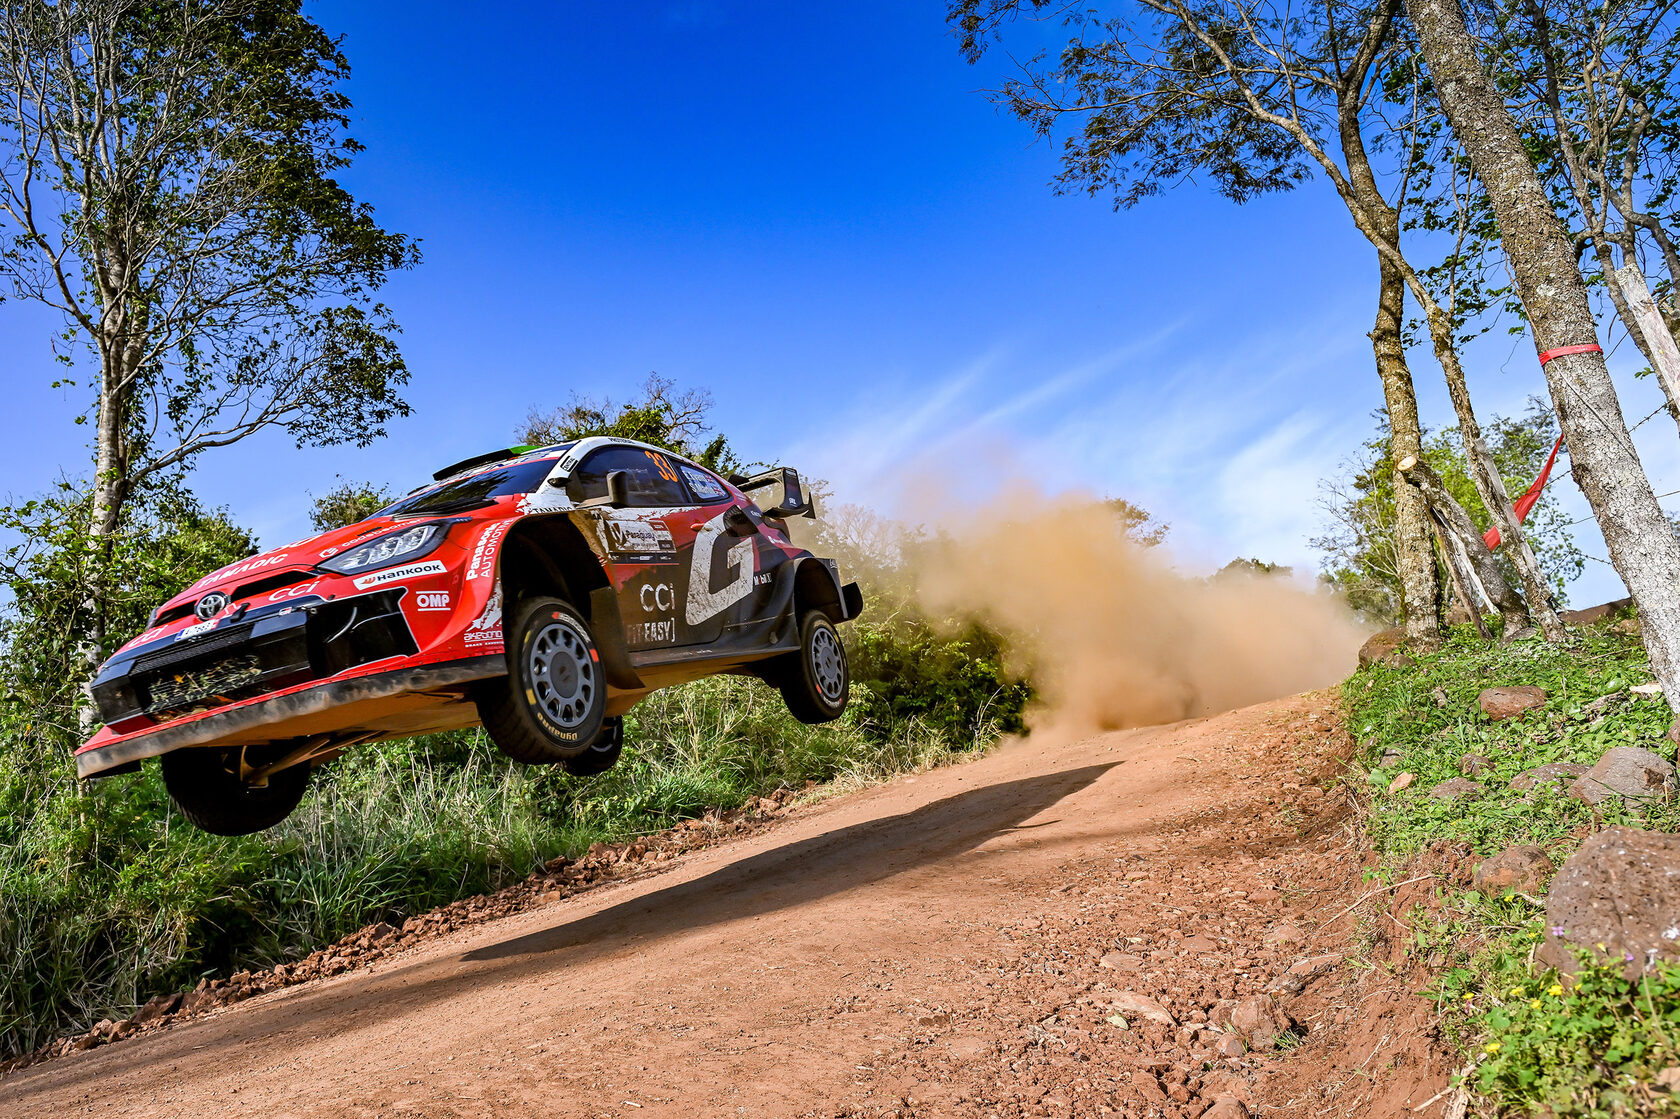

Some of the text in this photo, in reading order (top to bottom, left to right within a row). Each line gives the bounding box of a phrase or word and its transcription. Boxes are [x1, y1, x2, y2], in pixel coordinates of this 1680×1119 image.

[644, 450, 678, 482] 33
[466, 522, 501, 581] Panasonic
[198, 553, 290, 589] TAMADIC
[416, 594, 450, 608] OMP
